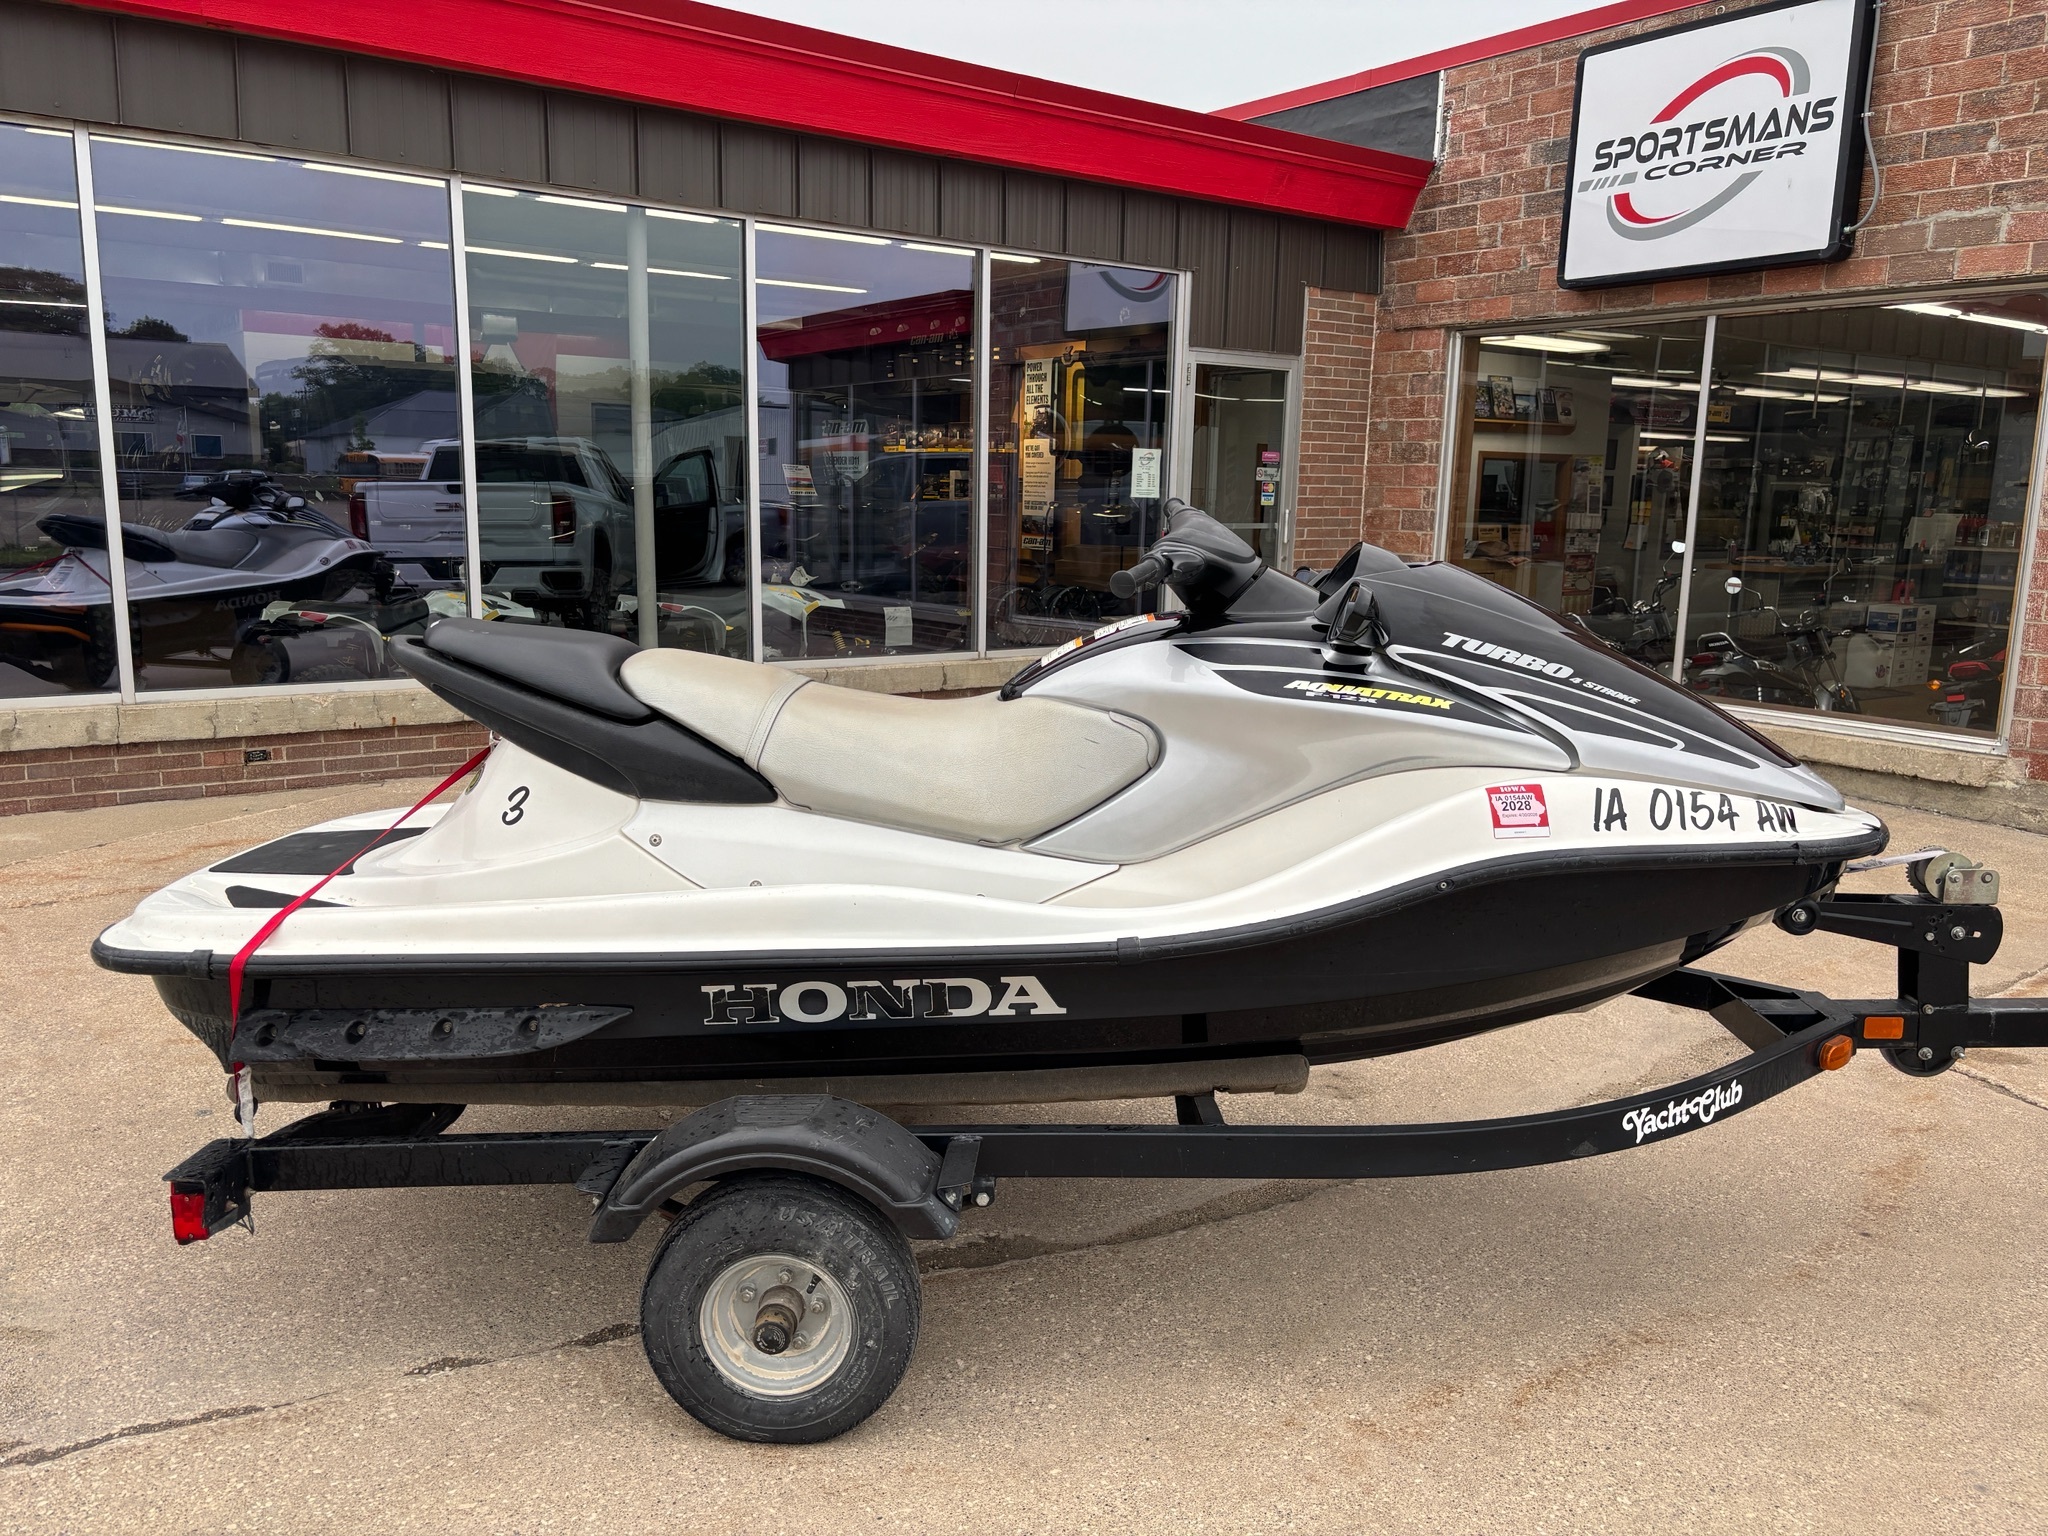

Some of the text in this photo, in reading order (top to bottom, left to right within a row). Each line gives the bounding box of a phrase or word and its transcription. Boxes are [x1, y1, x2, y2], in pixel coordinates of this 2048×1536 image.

[1592, 96, 1838, 172] SPORTSMANS
[1644, 141, 1808, 180] CORNER
[1026, 362, 1042, 372] POWER
[1026, 372, 1047, 383] THROUGH
[1026, 384, 1043, 394] ALL THE
[1026, 394, 1048, 405] ELEMENTS
[1441, 631, 1574, 679] TURBO
[1582, 681, 1641, 705] STROKE
[1283, 680, 1455, 710] AQUATRAX
[501, 785, 530, 826] 3
[1501, 800, 1532, 811] 2028
[1593, 787, 1799, 833] IA 0154 AW
[701, 975, 1067, 1025] HONDA
